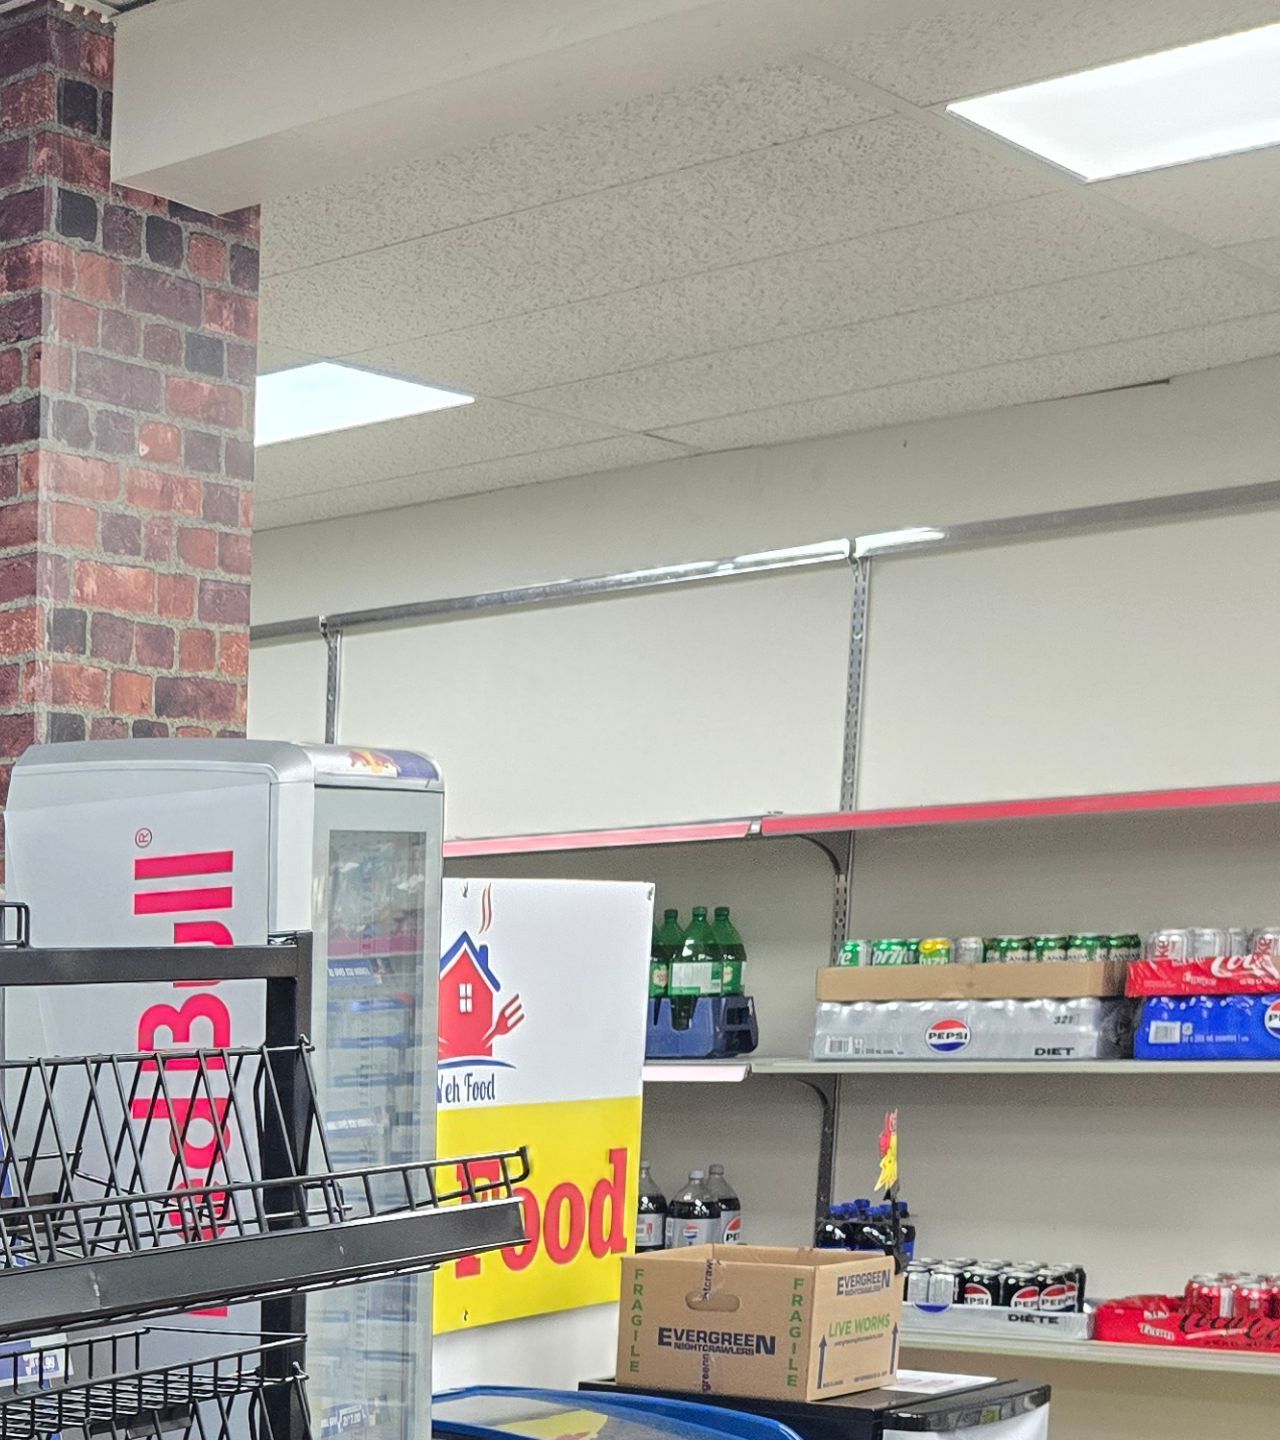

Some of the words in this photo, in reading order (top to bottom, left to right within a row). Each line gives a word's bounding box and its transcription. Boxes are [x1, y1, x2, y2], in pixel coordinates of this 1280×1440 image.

[928, 1032, 968, 1041] PEPSI
[1035, 1047, 1075, 1056] DIET
[464, 1073, 496, 1101] Food
[837, 1269, 891, 1297] EVERGREEN
[630, 1268, 645, 1373] FRAGILE
[786, 1277, 806, 1387] FRAGILE
[828, 1317, 853, 1338] LIVE
[854, 1313, 892, 1333] WORMS
[657, 1327, 776, 1356] EVERGREEN
